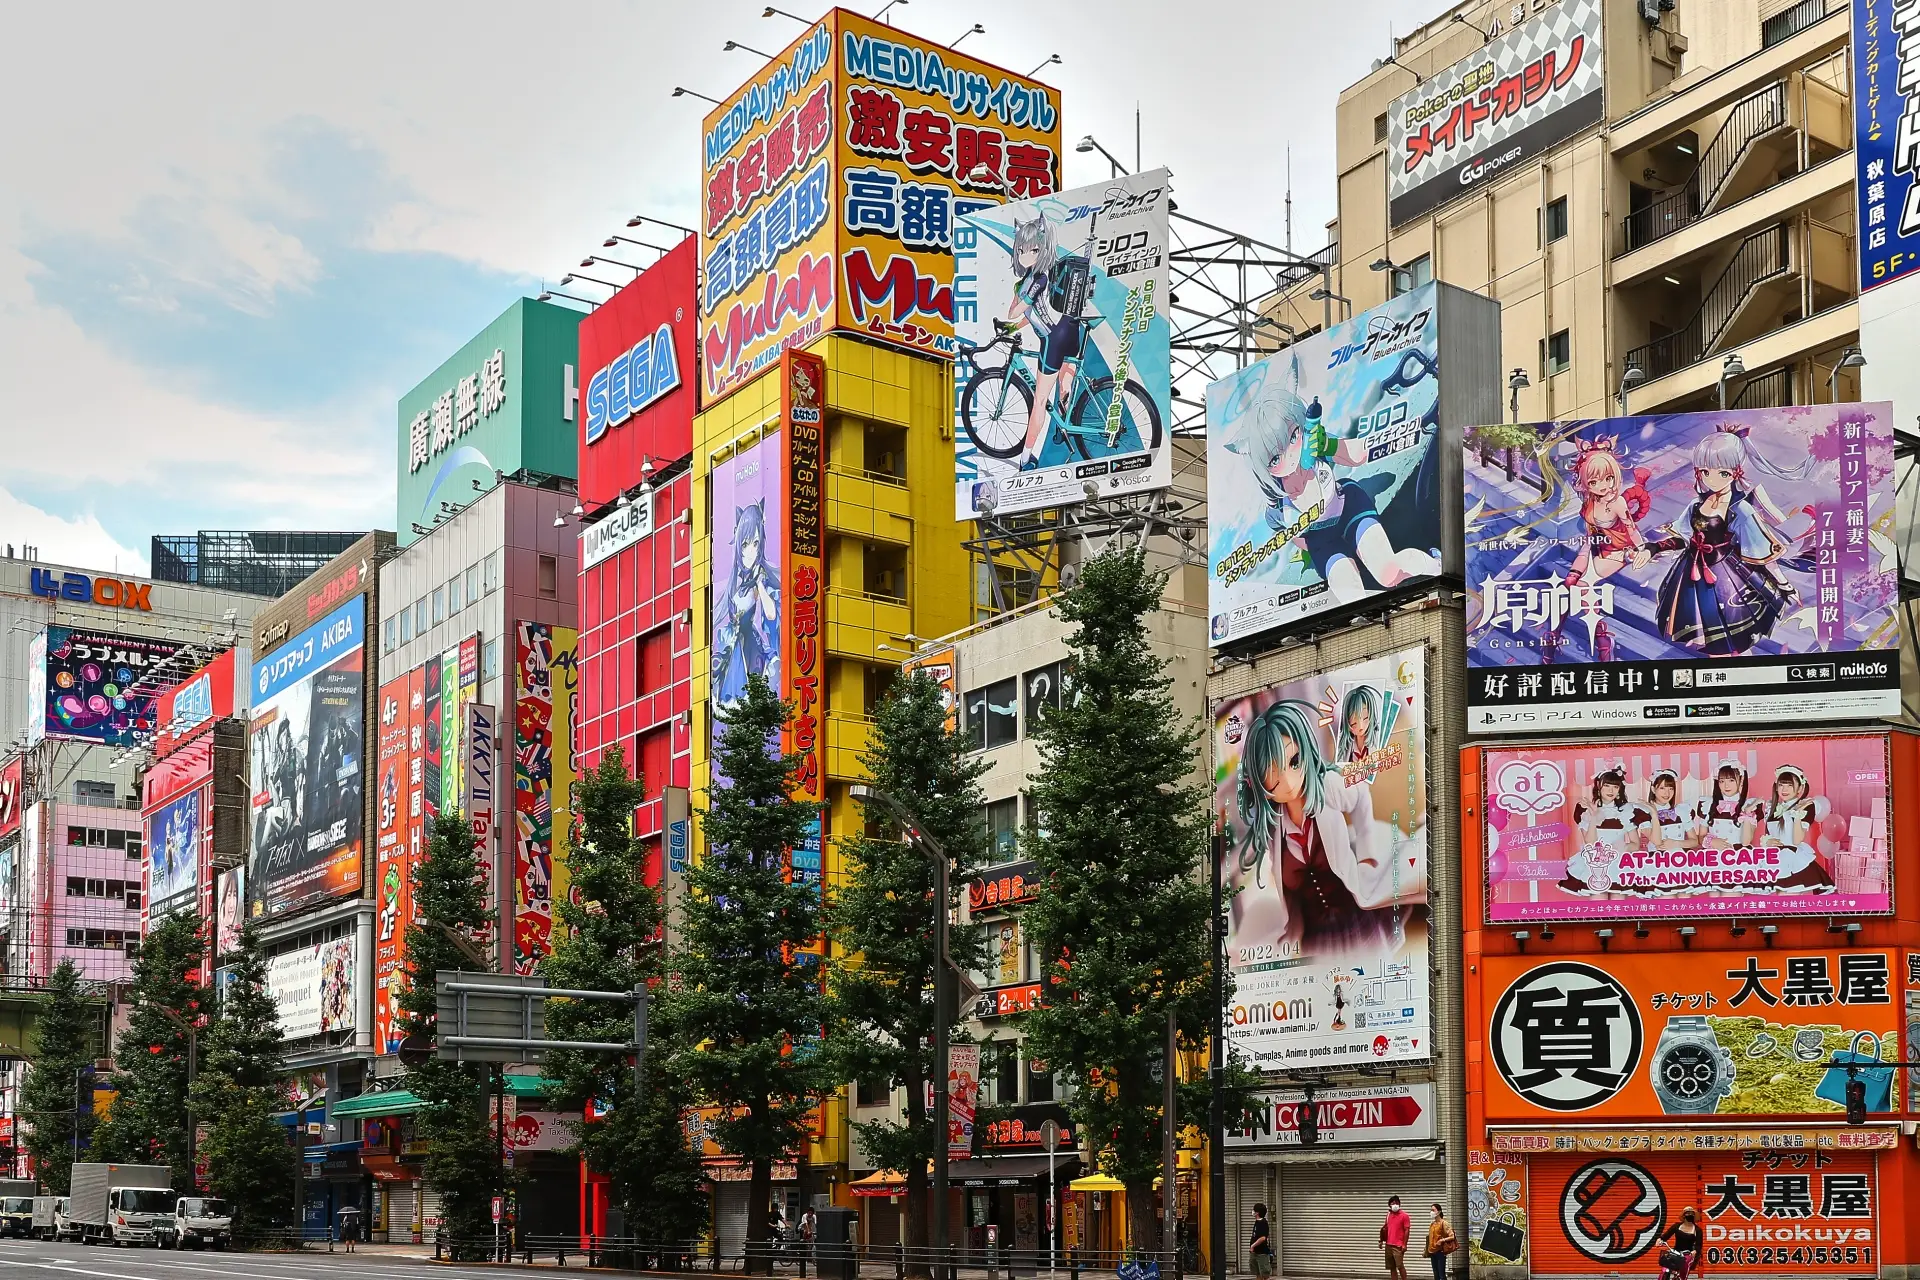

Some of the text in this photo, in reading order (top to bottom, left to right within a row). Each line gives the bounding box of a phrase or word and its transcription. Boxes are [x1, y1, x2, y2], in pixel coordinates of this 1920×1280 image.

[1404, 34, 1585, 174] メイドカジノ
[847, 87, 1053, 198] 激安販売
[1866, 158, 1887, 251] 秋葉原店
[704, 160, 829, 314] 高額買取
[1096, 230, 1149, 258] シロコ
[954, 224, 979, 325] BLUE
[1137, 278, 1156, 332] 8月12日
[705, 252, 834, 394] Mulan
[868, 315, 933, 347] ムーラン
[585, 322, 683, 447] SEGA
[792, 408, 819, 422] あなたの
[1357, 401, 1409, 440] シロコ
[794, 425, 818, 441] DVD
[792, 440, 818, 456] ブルーレイ
[793, 456, 818, 471] ゲーム
[797, 469, 814, 483] CD
[1006, 474, 1044, 490] ブルアカ
[793, 483, 818, 498] アイドル
[793, 498, 818, 512] アニメ
[600, 501, 648, 546] MC-UBS
[793, 512, 817, 526] コミック
[794, 526, 817, 540] ホビー
[1478, 535, 1613, 552] 新世代オープンワールドRPG
[793, 540, 818, 555] フィギュア
[1216, 541, 1254, 579] 8月12日
[1233, 605, 1259, 620] ブルアカ
[1475, 550, 1616, 657] 原神
[260, 620, 290, 651] Sofmap
[1489, 636, 1570, 649] Genshin
[270, 615, 353, 683] ソフマップ AKIBA
[1701, 671, 1728, 683] 原神
[1805, 667, 1831, 679] 検索
[1483, 669, 1661, 699] 好評配信中!
[383, 694, 398, 726] 4F
[1591, 706, 1638, 721] Windows
[473, 708, 491, 786] AKKY
[1854, 771, 1879, 784] OPEN
[381, 797, 396, 830] 3F
[670, 820, 687, 874] SEGA
[804, 838, 820, 851] 中古
[1508, 828, 1559, 848] Akihabara
[794, 856, 819, 868] DVD
[1618, 846, 1780, 871] AT-HOME CAFE
[792, 870, 804, 881] 4F
[985, 875, 1024, 905] 吉野家
[380, 908, 395, 941] 2F
[379, 944, 396, 959] プライズ
[1240, 941, 1300, 962] 2022.04
[379, 958, 404, 974] レトロゲーム
[1251, 962, 1275, 973] STORE
[1727, 954, 1891, 1008] 大黒屋
[278, 982, 312, 1006] Bouquet
[1651, 991, 1719, 1011] チケット
[1233, 997, 1313, 1027] amiami
[1230, 1022, 1320, 1039] https://www.amiami.jp/
[1508, 983, 1627, 1092] 質
[1254, 1042, 1369, 1062] Gunplas, Anime goods and more
[1339, 1089, 1366, 1099] Magazine
[1374, 1086, 1410, 1095] MANGA-ZIN
[1352, 1101, 1383, 1125] ZIN
[1494, 1135, 1550, 1149] 高価買取
[1837, 1132, 1896, 1148] 無料査定
[1741, 1150, 1833, 1170] チケット
[1704, 1174, 1873, 1220] 大黒屋
[1705, 1224, 1872, 1246] Daikokuya
[1706, 1245, 1873, 1266] 03(3254)5351
